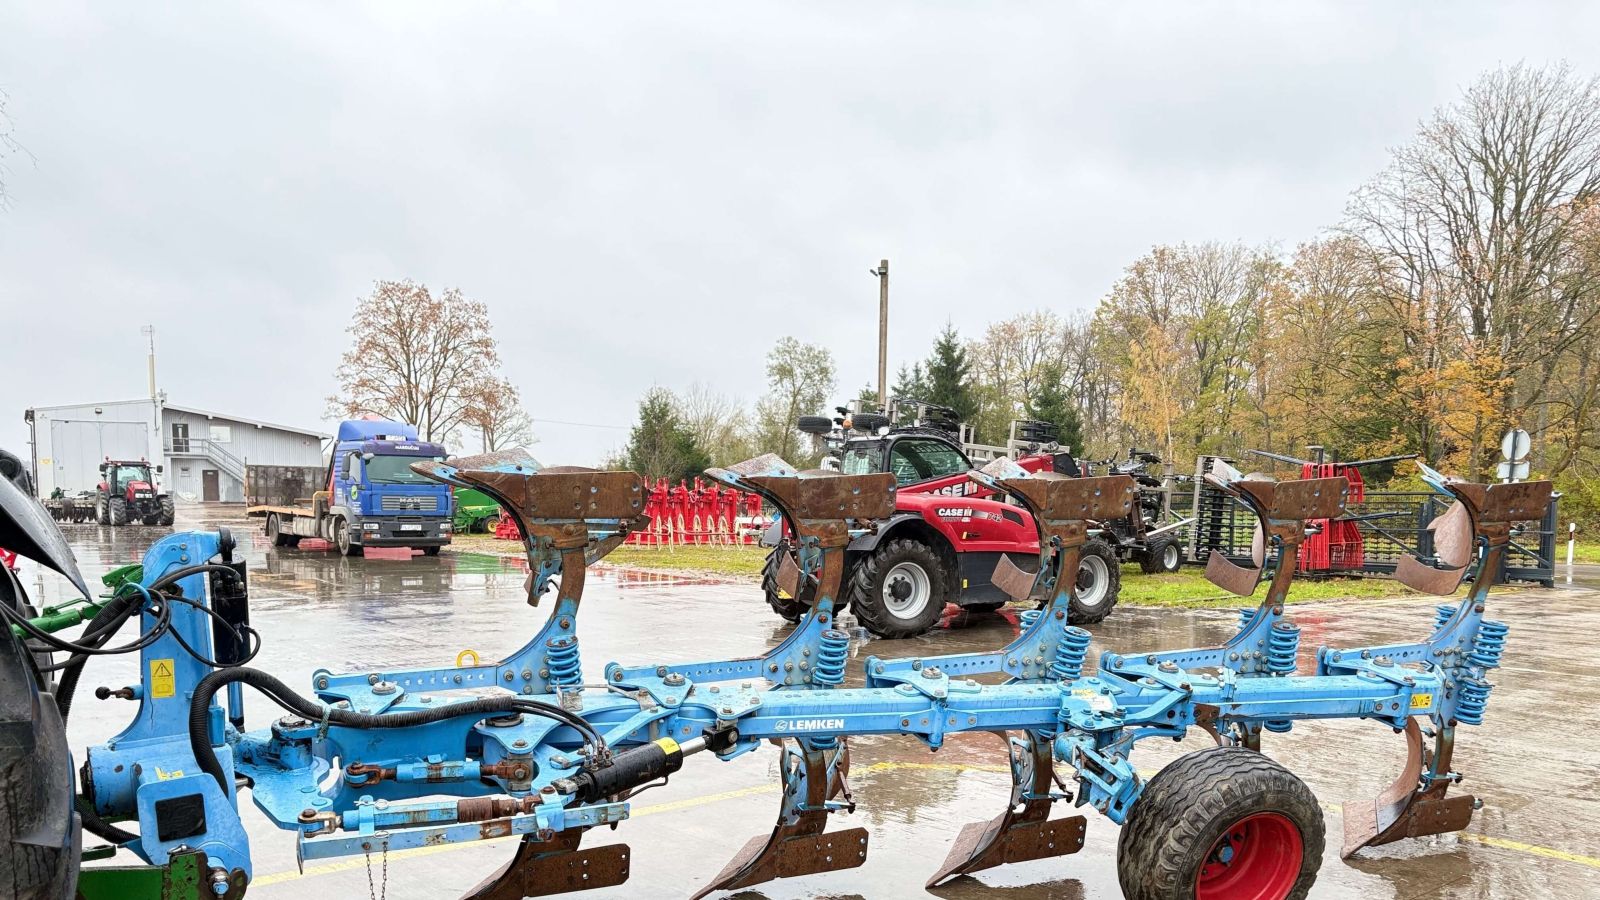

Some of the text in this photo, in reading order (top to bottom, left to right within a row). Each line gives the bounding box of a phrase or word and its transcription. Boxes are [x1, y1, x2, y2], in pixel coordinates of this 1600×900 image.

[938, 508, 963, 517] CASE
[987, 512, 1003, 522] 742
[789, 719, 845, 731] LEMKEN
